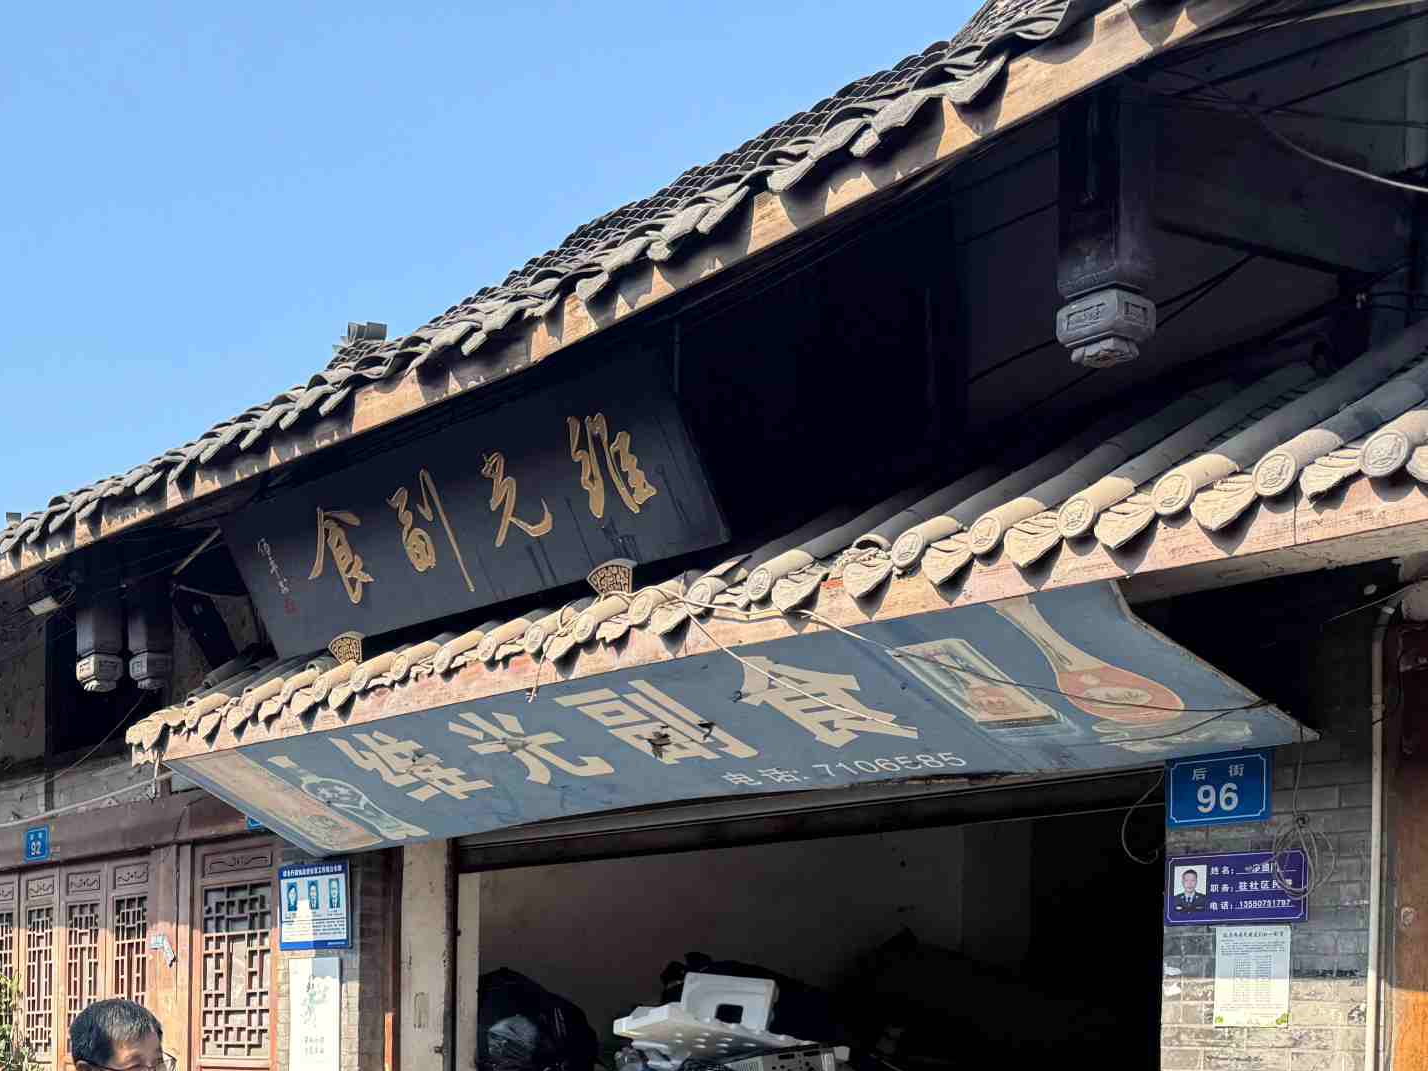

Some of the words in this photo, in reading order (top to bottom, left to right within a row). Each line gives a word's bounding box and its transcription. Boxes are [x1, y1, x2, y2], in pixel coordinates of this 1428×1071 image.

[329, 656, 918, 801] 维光副食
[812, 751, 968, 777] 7106585
[1191, 763, 1245, 781] 后街
[1196, 782, 1240, 814] 96
